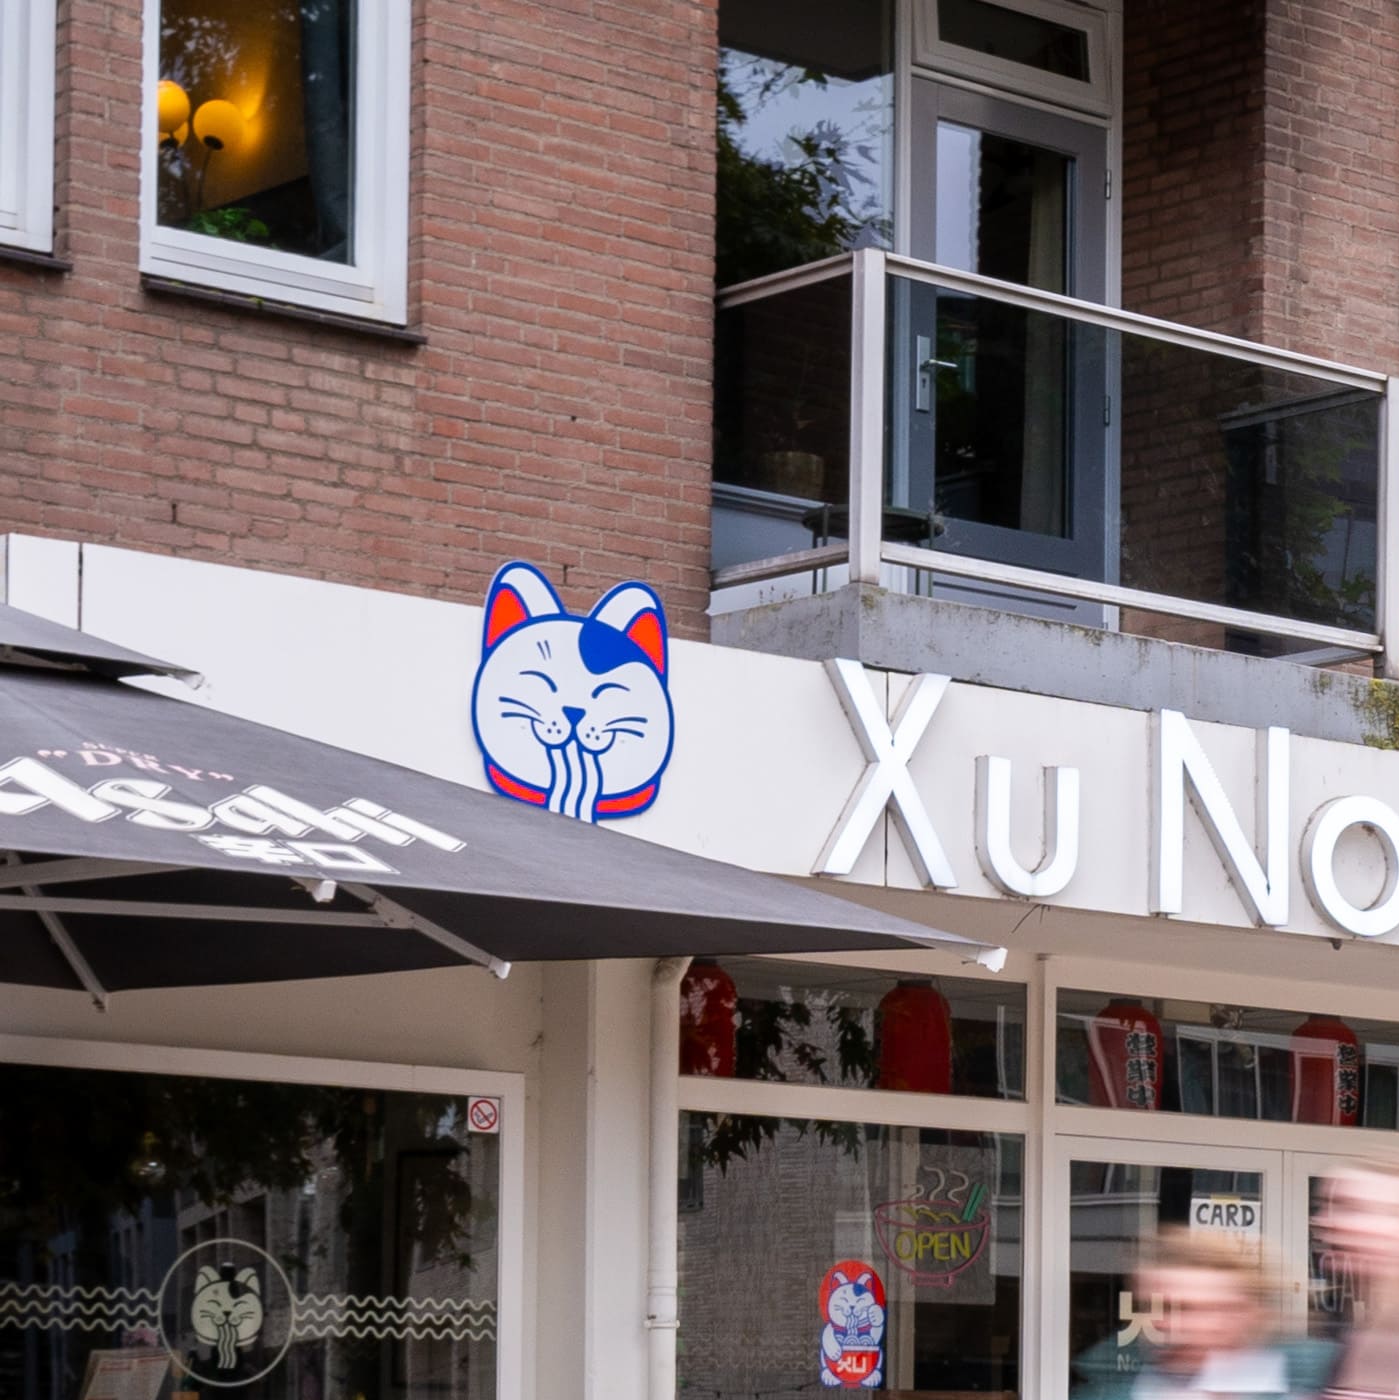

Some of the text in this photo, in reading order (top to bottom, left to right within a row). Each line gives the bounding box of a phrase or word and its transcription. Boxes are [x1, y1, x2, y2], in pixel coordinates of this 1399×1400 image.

[811, 656, 1080, 898] Xu
[1196, 1203, 1256, 1228] CARD
[896, 1230, 972, 1262] OPEN
